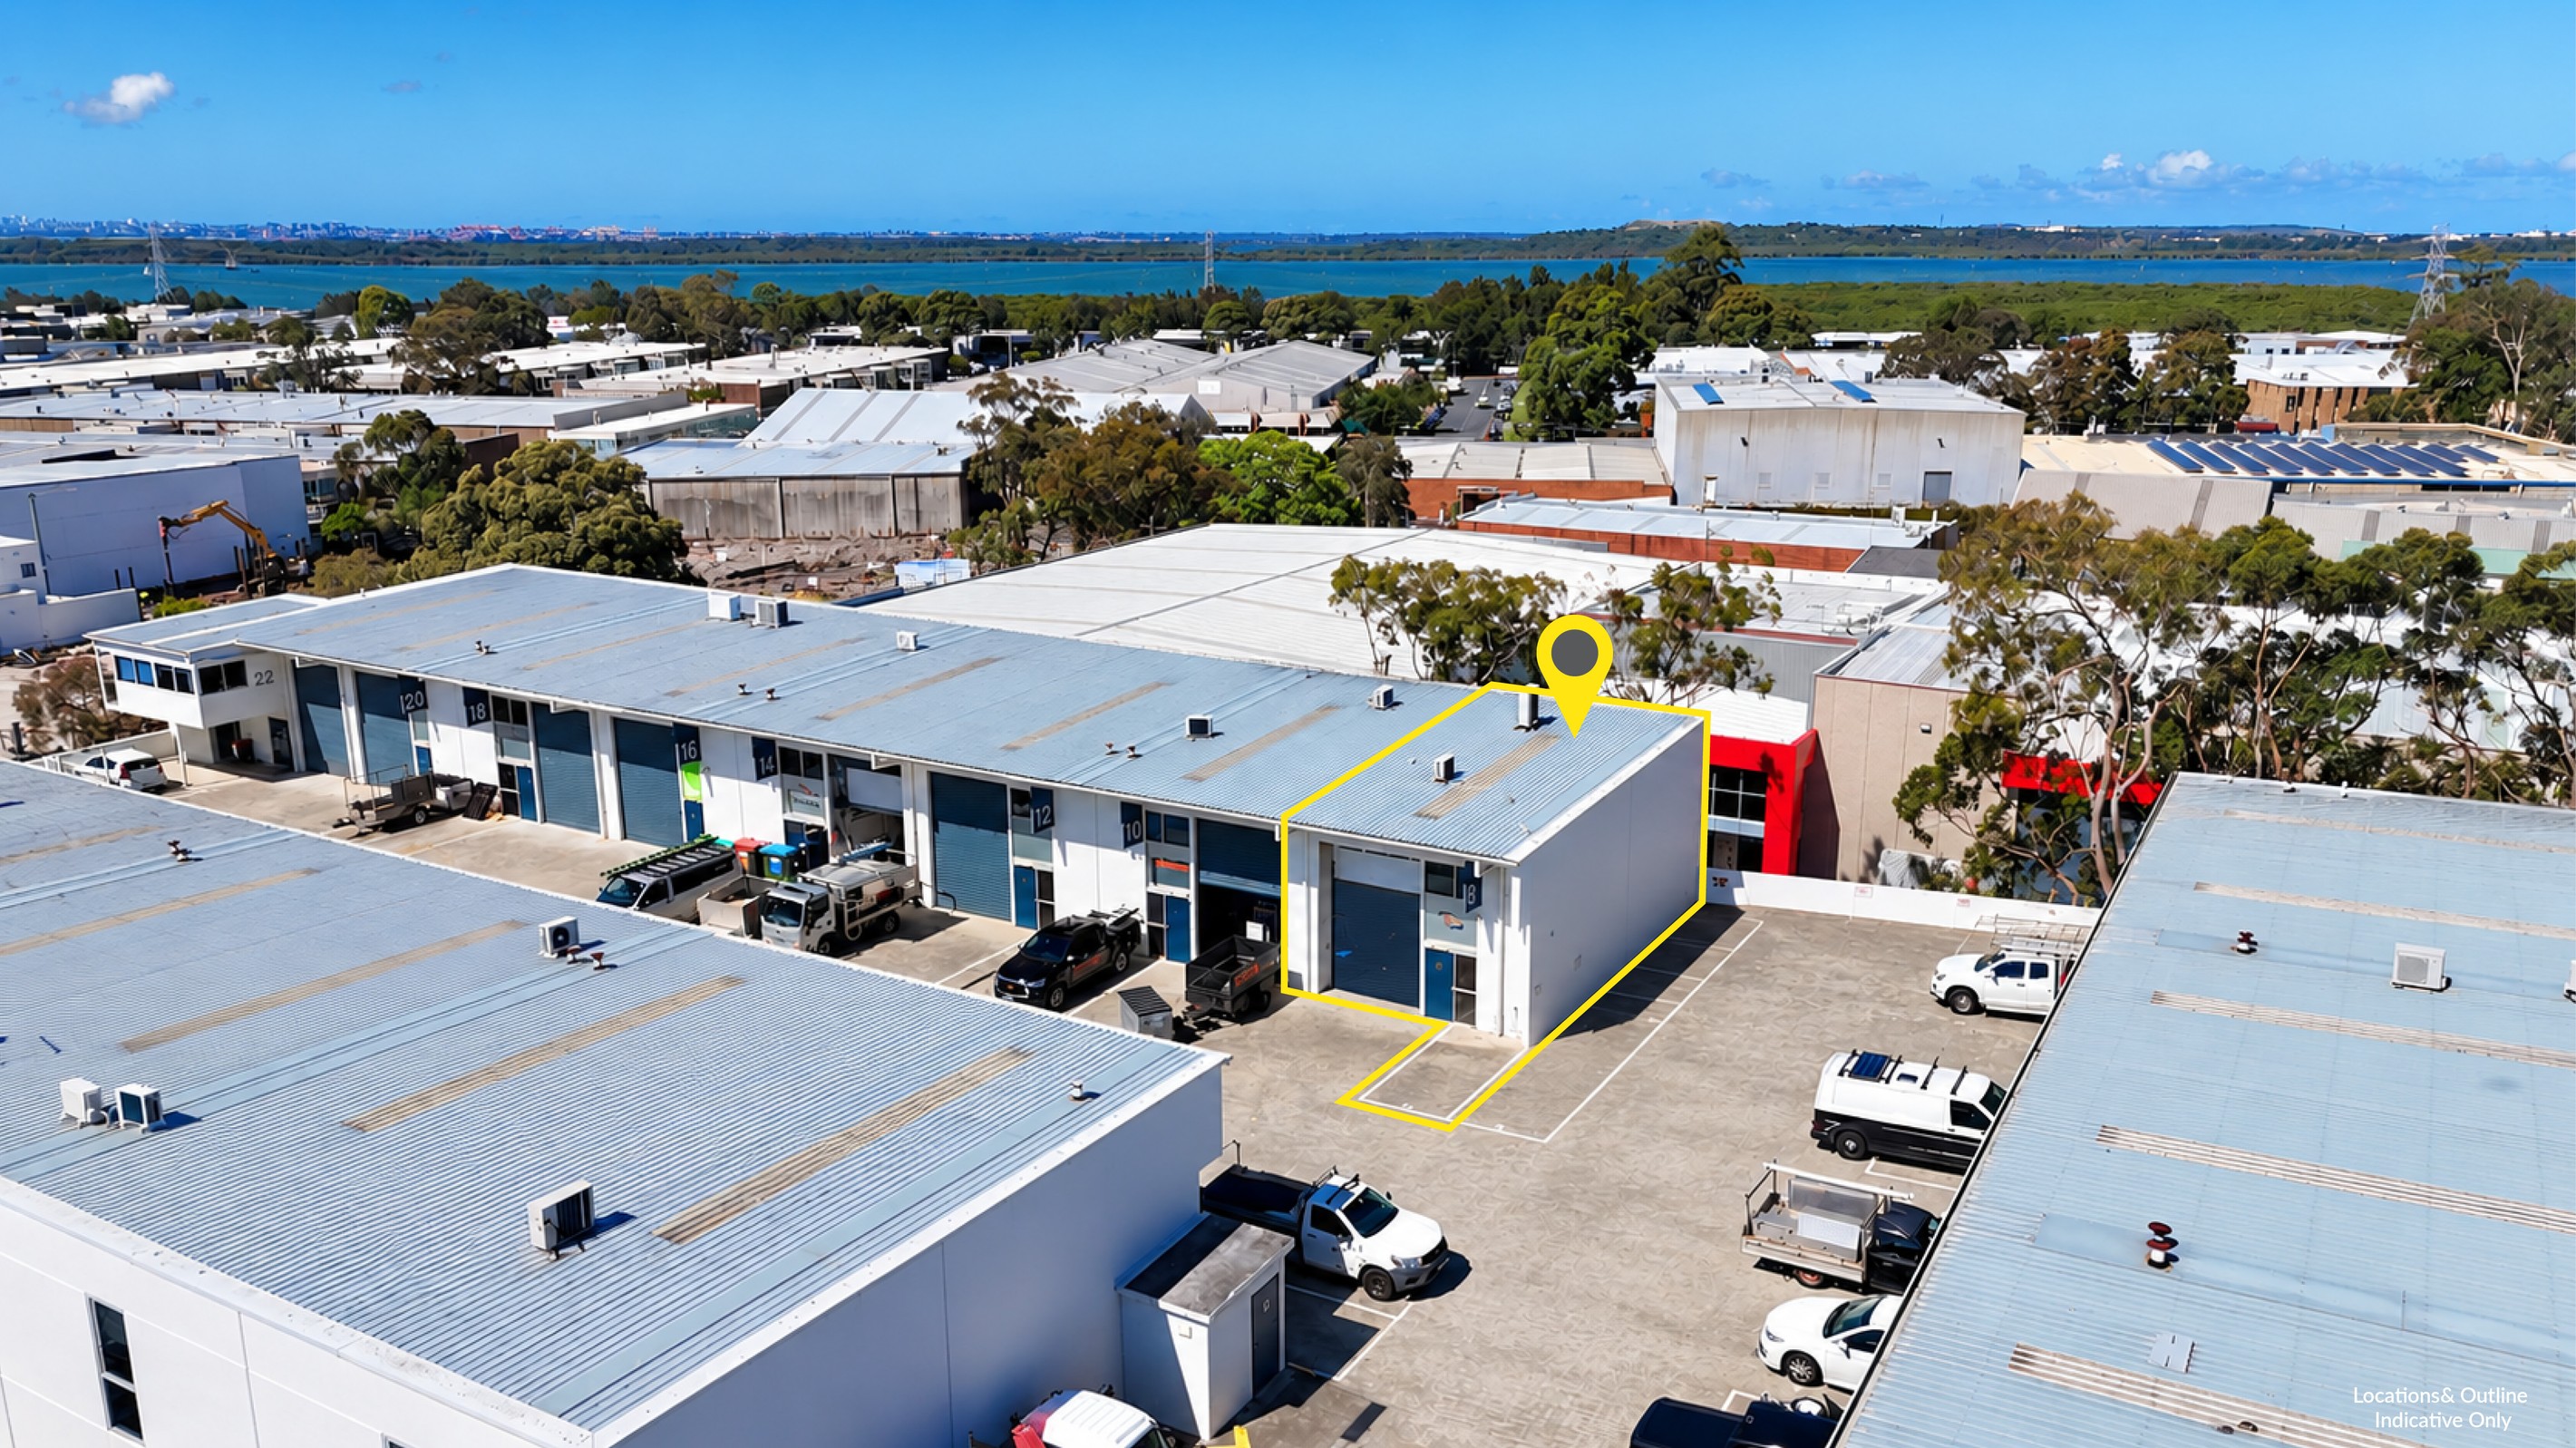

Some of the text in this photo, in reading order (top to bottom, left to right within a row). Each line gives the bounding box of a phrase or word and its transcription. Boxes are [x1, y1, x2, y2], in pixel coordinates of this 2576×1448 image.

[254, 670, 274, 686] 22
[407, 690, 425, 710] 20
[469, 702, 486, 722] 18
[681, 739, 697, 761] 16
[1035, 805, 1052, 828] 12
[1124, 820, 1142, 841] 10
